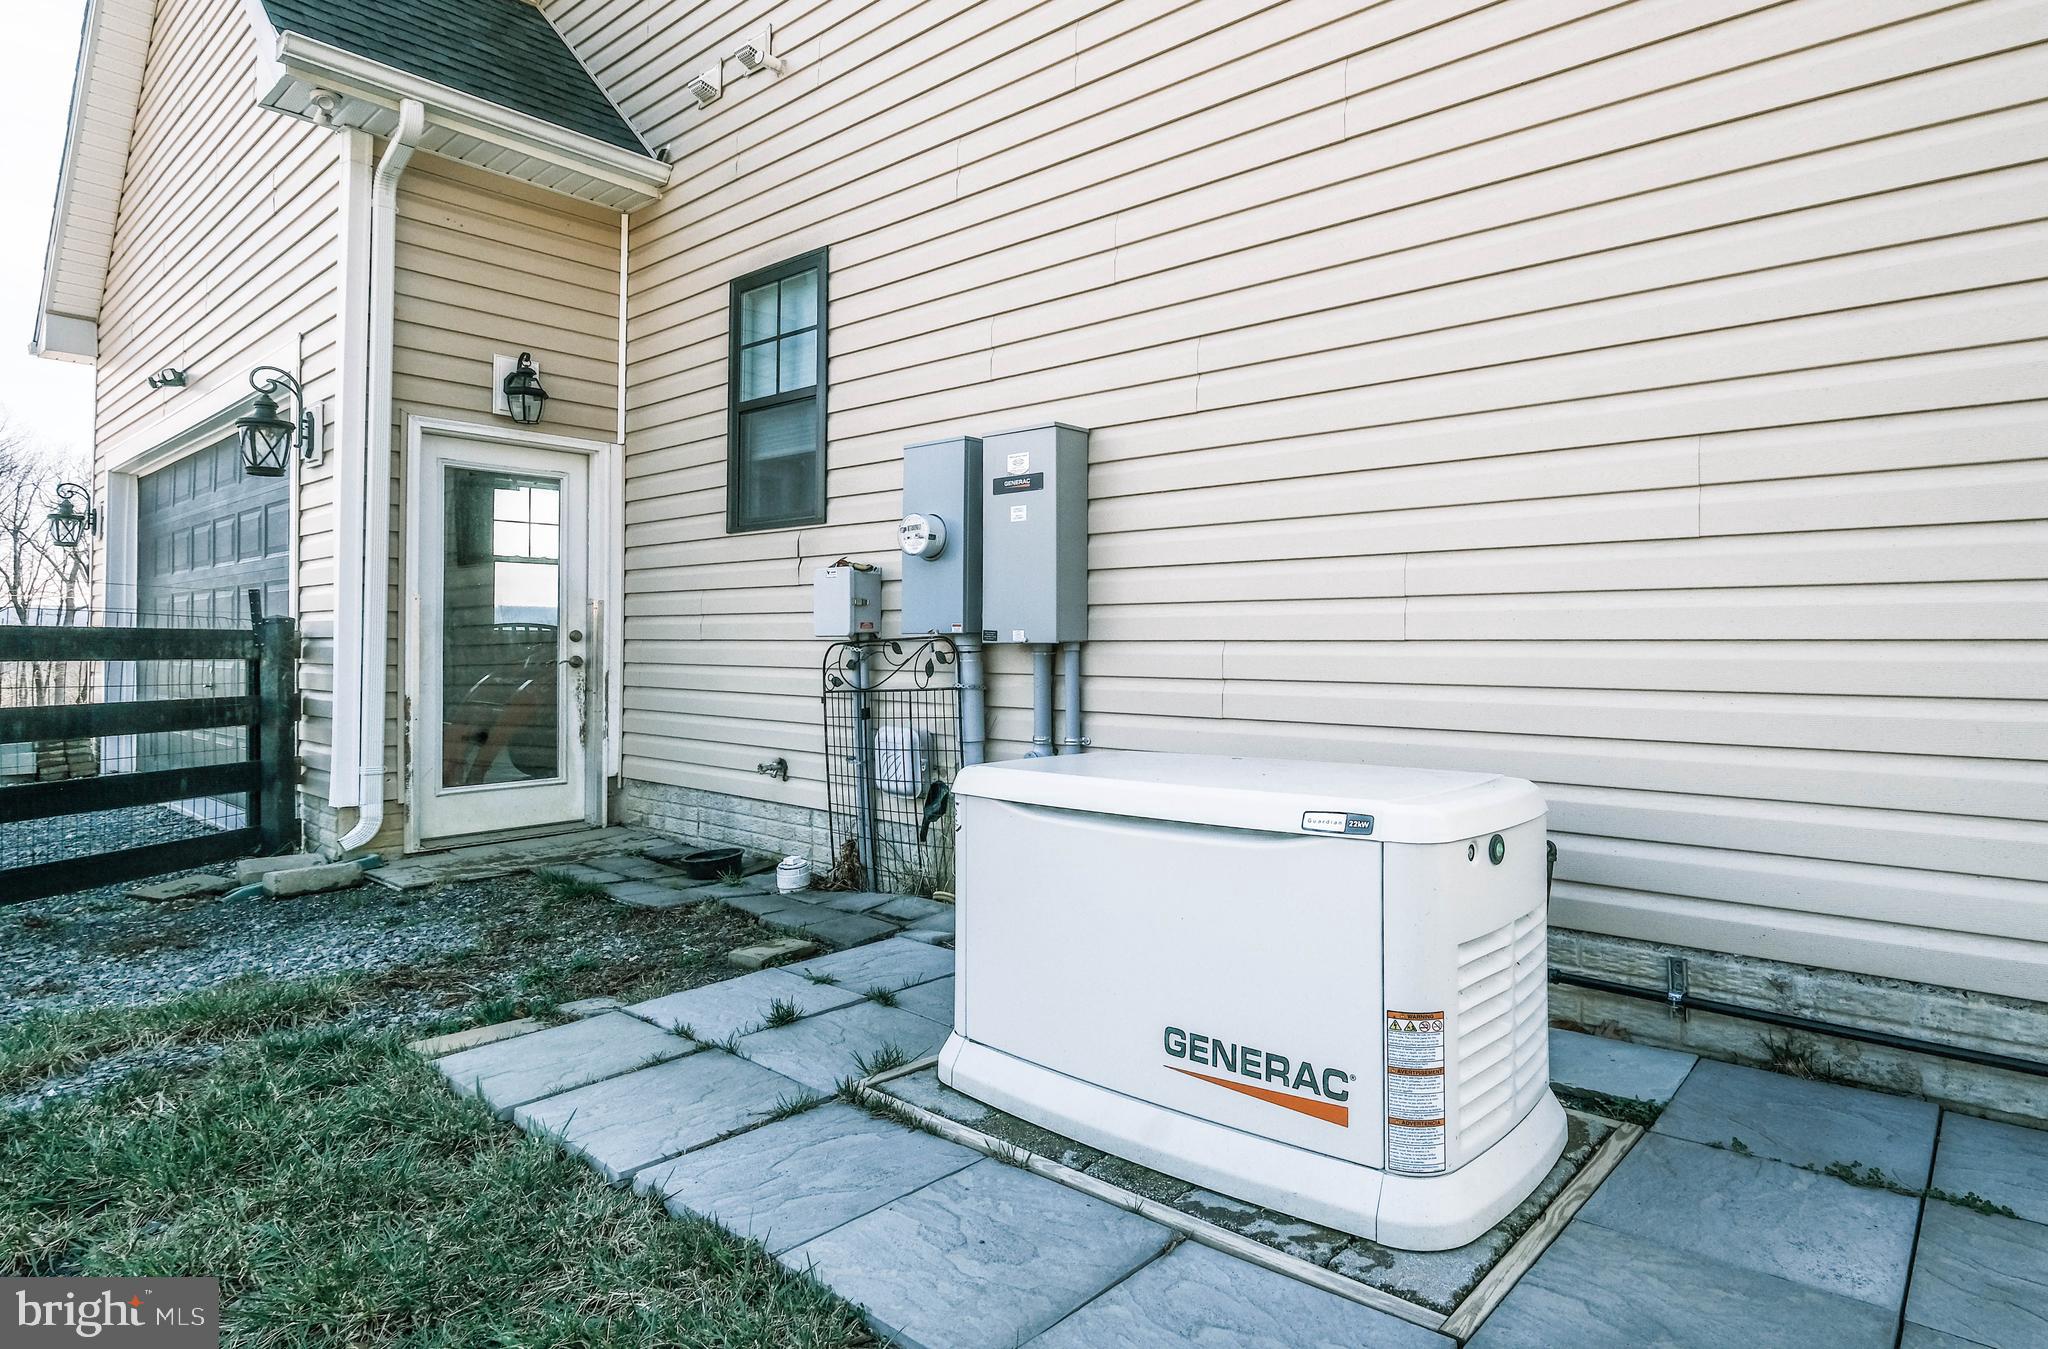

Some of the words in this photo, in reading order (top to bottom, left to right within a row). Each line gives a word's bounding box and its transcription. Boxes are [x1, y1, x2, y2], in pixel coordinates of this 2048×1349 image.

[1004, 478, 1031, 487] GENERAC
[1307, 817, 1343, 825] Guardian
[1348, 820, 1370, 829] 22kW
